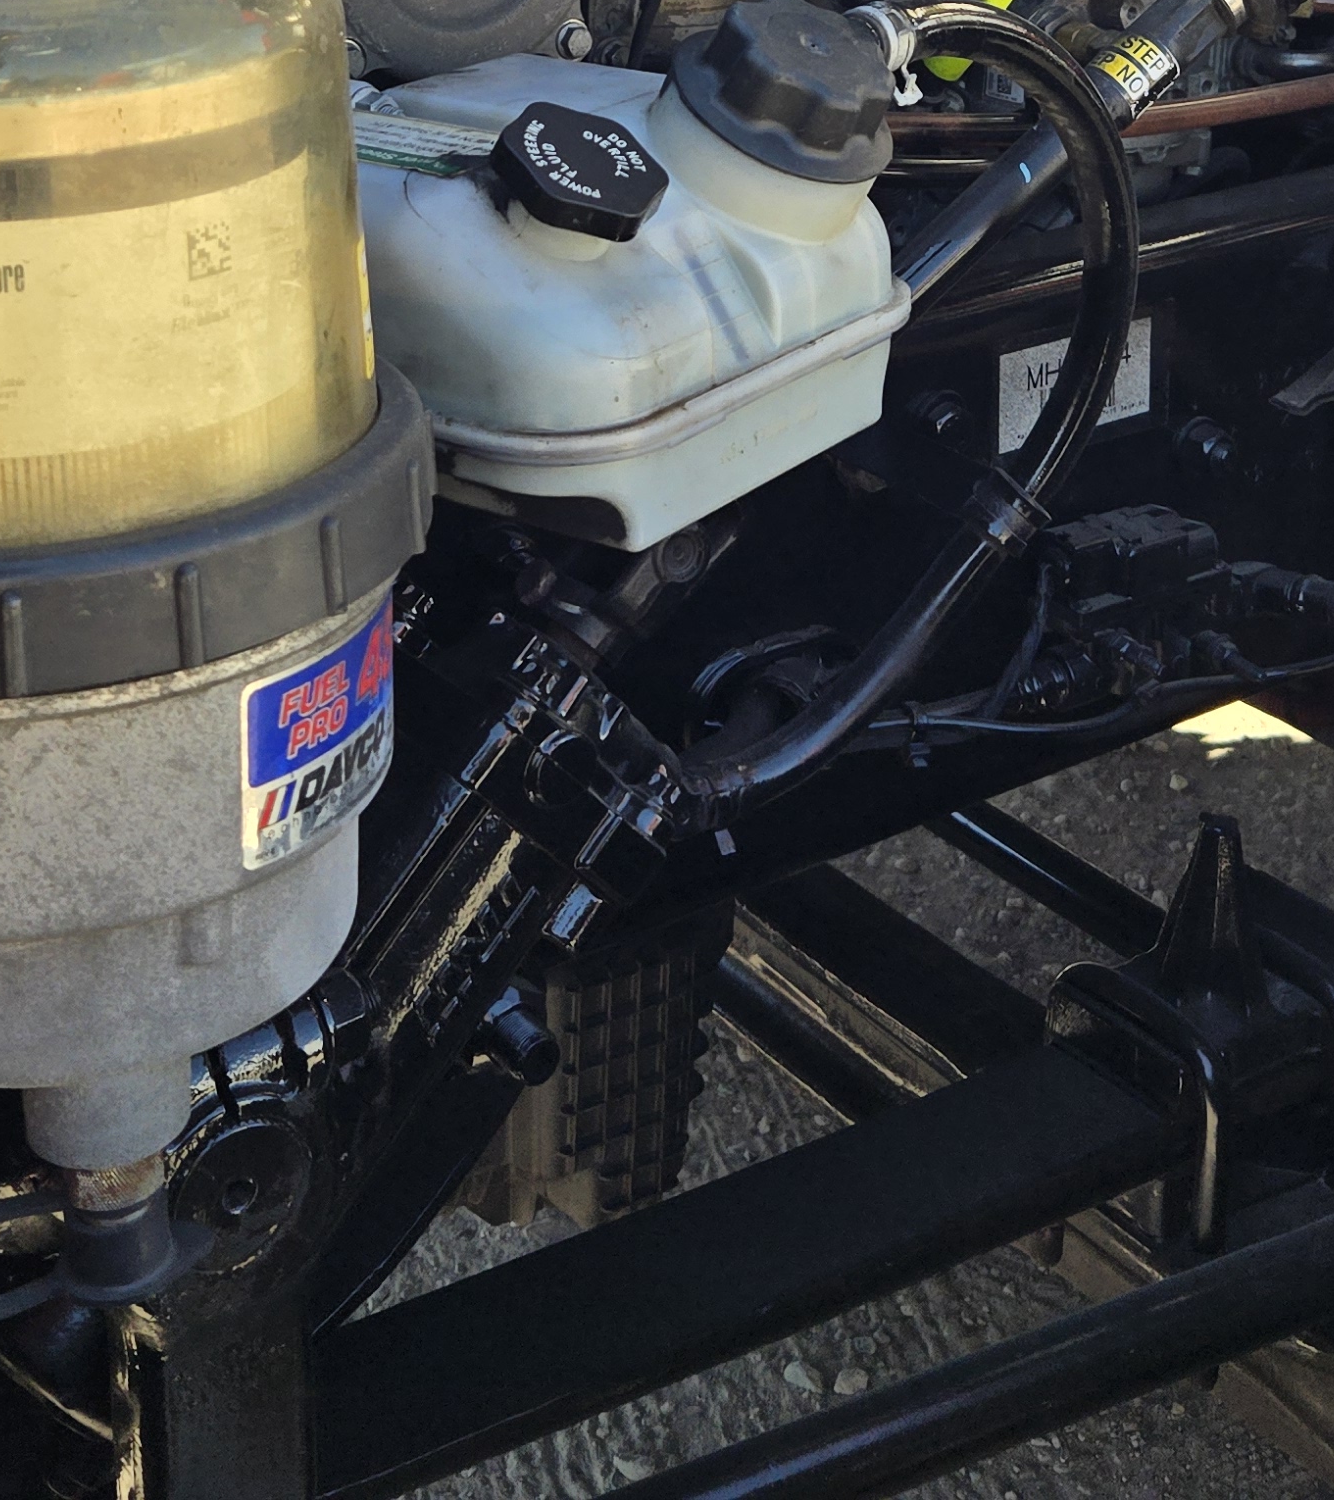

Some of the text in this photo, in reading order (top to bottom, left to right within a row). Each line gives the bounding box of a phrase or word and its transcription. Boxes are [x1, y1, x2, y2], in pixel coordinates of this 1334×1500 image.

[1121, 35, 1165, 70] STEP
[1116, 64, 1144, 93] NO
[523, 119, 601, 199] POWER STEERING
[541, 142, 578, 179] FLUID
[582, 130, 630, 178] OVERFILL
[607, 132, 646, 172] DO NOT
[278, 660, 350, 728] FUEL
[286, 694, 349, 761] PRO
